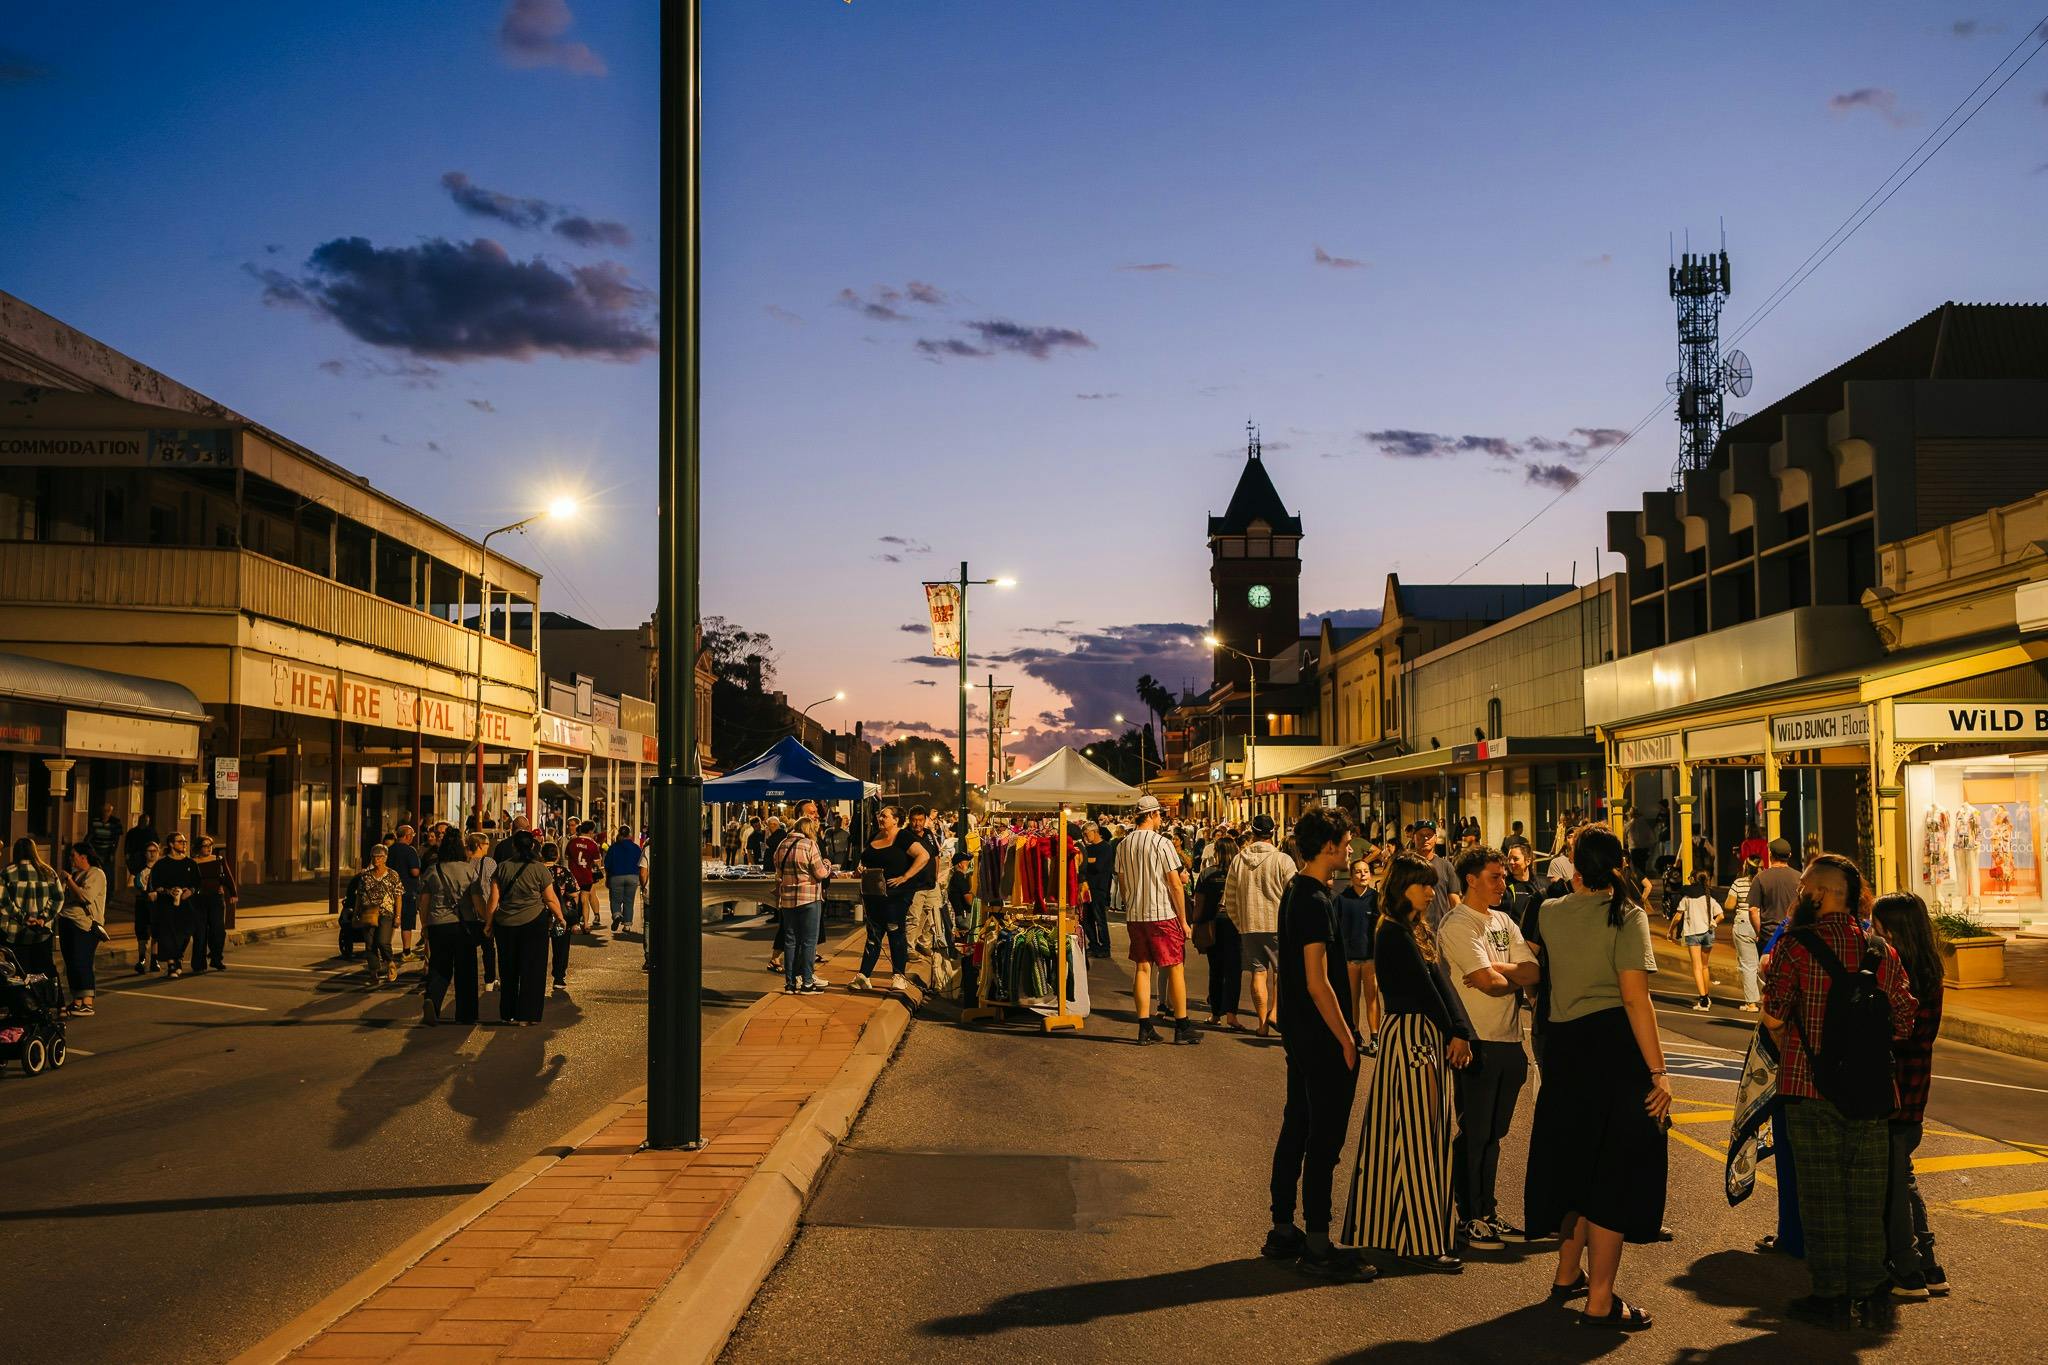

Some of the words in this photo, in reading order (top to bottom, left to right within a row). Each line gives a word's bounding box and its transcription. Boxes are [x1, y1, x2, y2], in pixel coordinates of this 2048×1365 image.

[271, 658, 381, 719] THEATRE
[393, 684, 454, 731] ROYAL
[1804, 717, 1837, 739] BUNCH
[217, 771, 226, 779] 2P
[577, 851, 587, 869] 4
